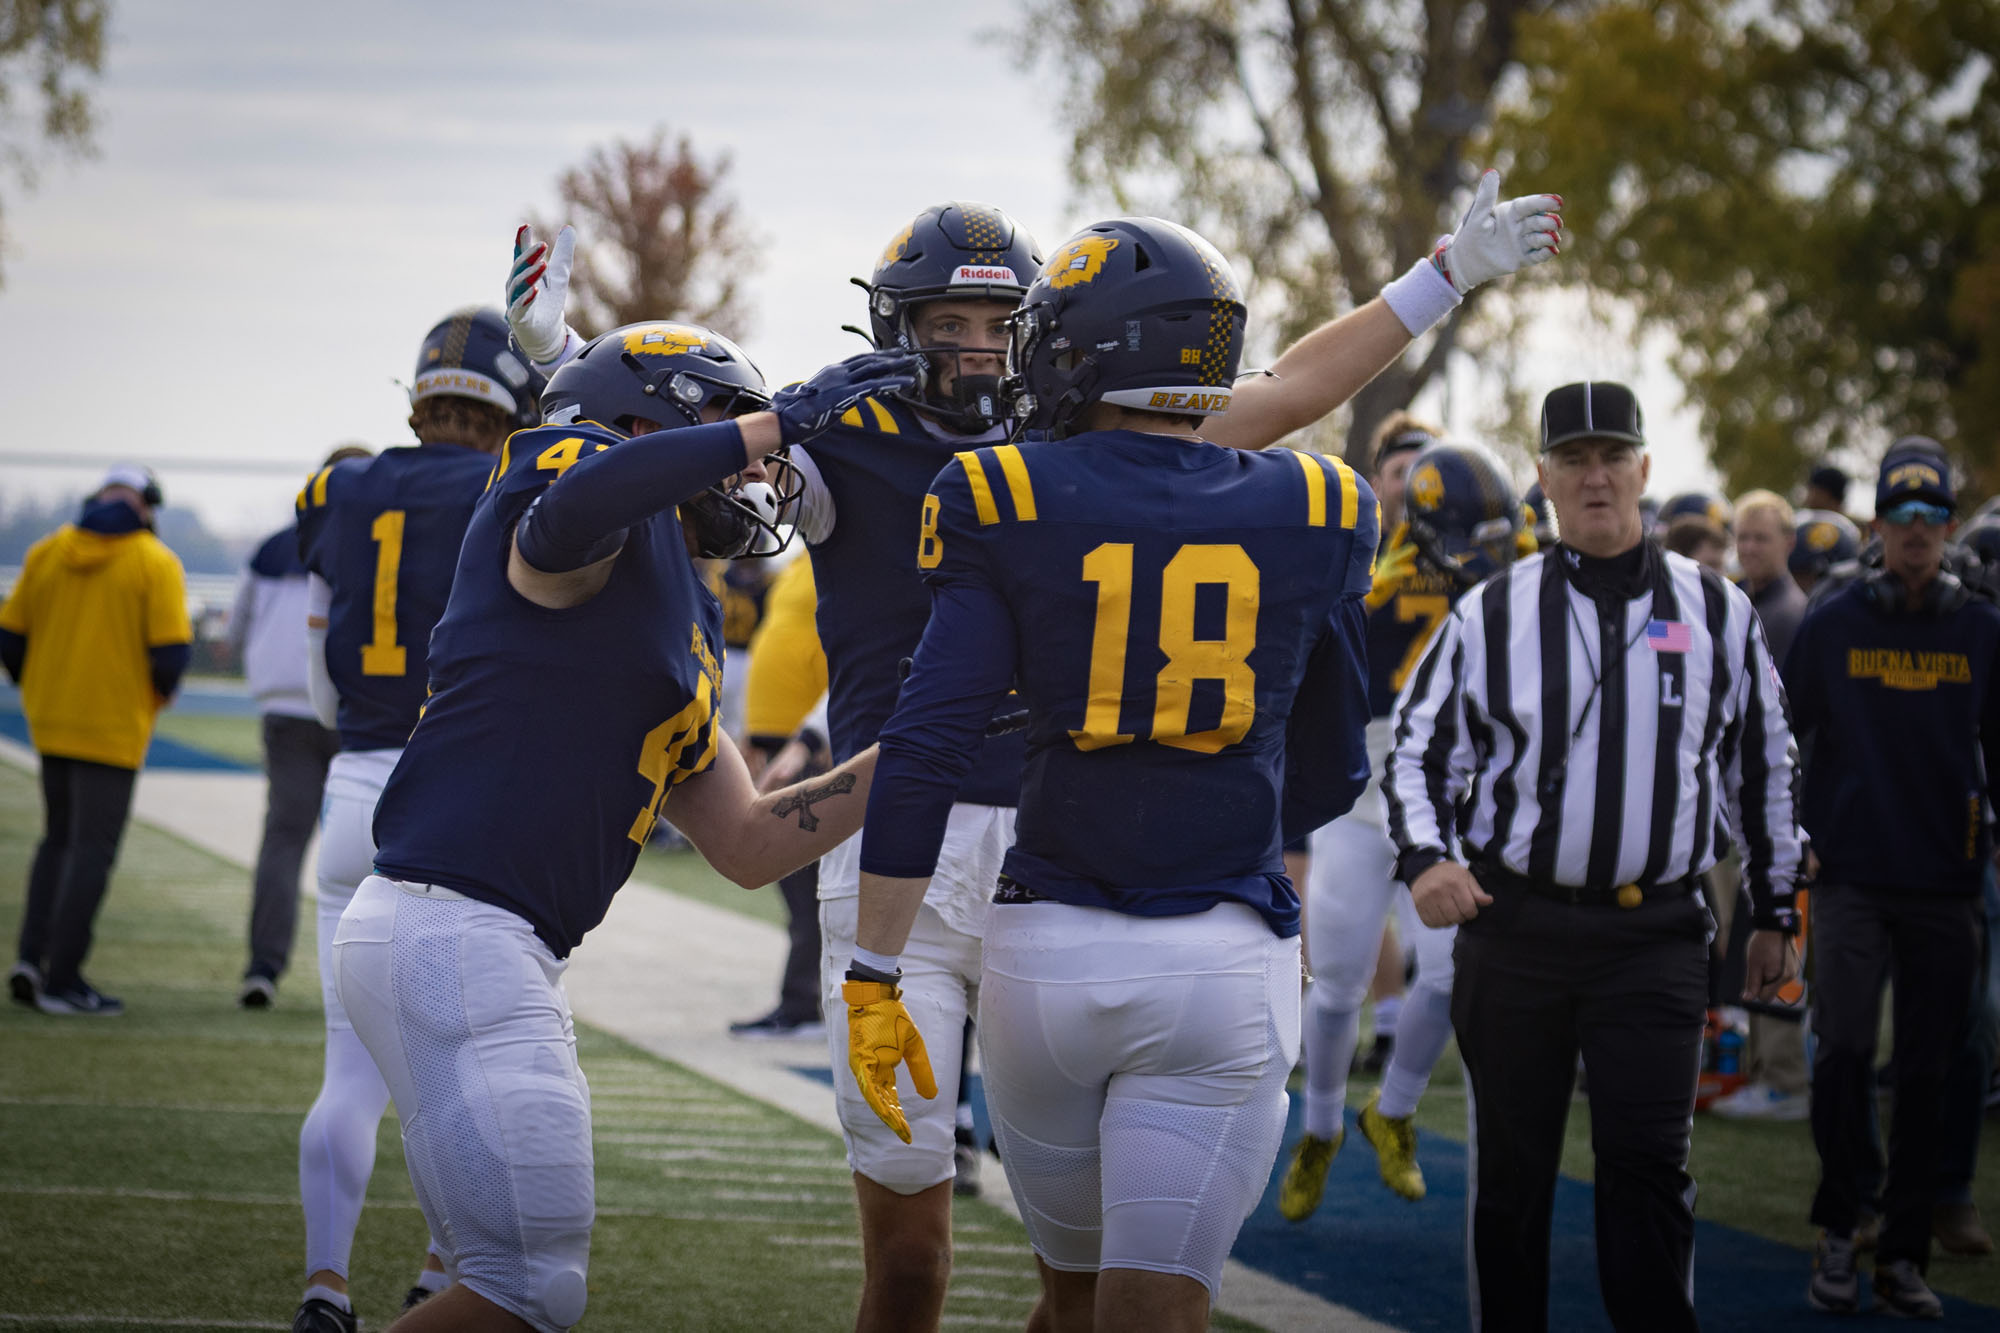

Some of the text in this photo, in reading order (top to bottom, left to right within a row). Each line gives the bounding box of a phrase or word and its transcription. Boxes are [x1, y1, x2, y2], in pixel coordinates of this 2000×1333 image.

[960, 268, 1010, 280] Riddell
[1180, 348, 1201, 365] BH
[417, 375, 490, 393] BEAVERS
[361, 510, 407, 677] 1
[1068, 542, 1261, 755] 18
[1389, 594, 1450, 693] 7
[1848, 647, 1915, 678] BUENA
[1916, 650, 1971, 684] VISTA
[1662, 672, 1682, 706] L
